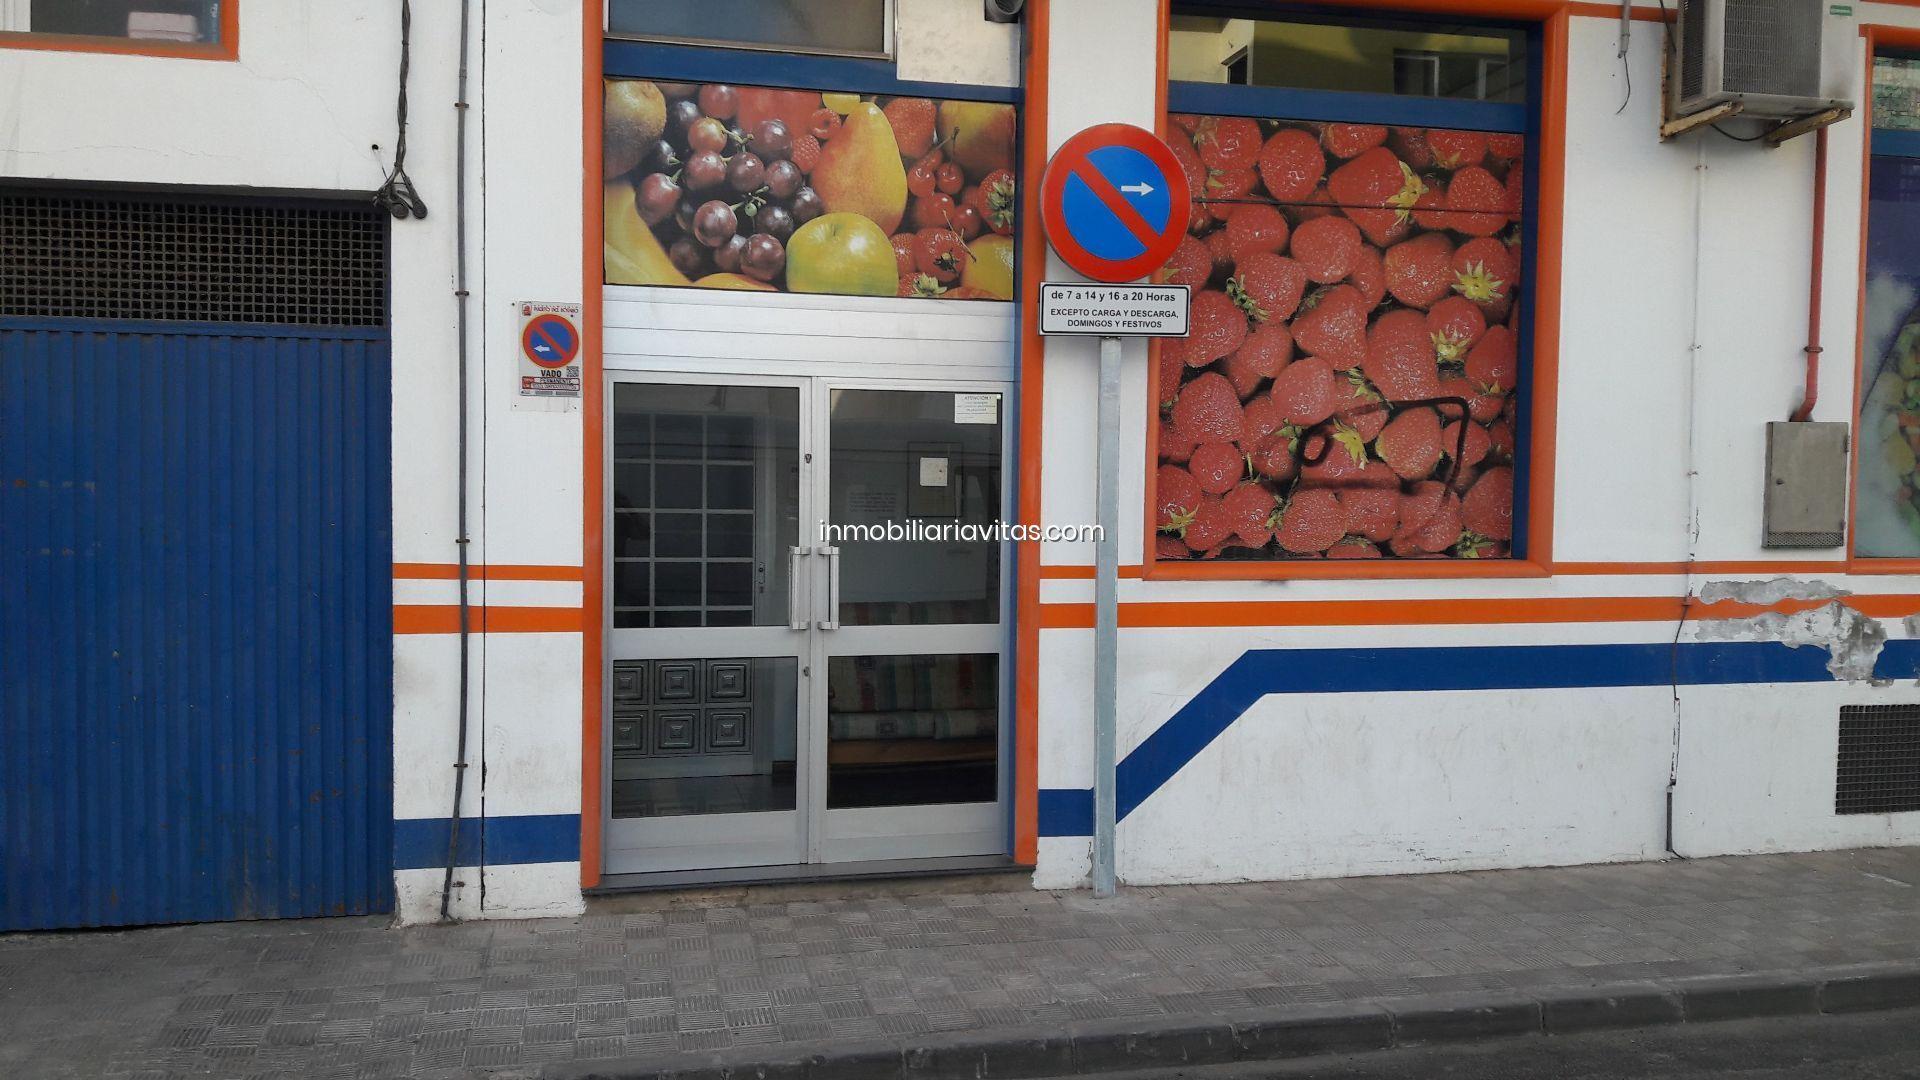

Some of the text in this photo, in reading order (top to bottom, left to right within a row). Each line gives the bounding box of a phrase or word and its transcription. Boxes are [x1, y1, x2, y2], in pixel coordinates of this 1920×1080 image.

[1051, 290, 1063, 299] de
[1067, 291, 1073, 299] 7
[1085, 291, 1096, 300] 14
[1099, 293, 1105, 302] y
[1108, 291, 1120, 301] 16
[1122, 293, 1129, 301] a
[1131, 292, 1143, 301] 20
[1146, 292, 1176, 302] Horas
[1050, 308, 1090, 316] EXCEPTO
[1092, 309, 1122, 317] CARGA
[1130, 310, 1179, 319] DESCARGA,
[1067, 320, 1162, 328] DOMINGOS Y FESTIVOS
[541, 369, 562, 378] VADO
